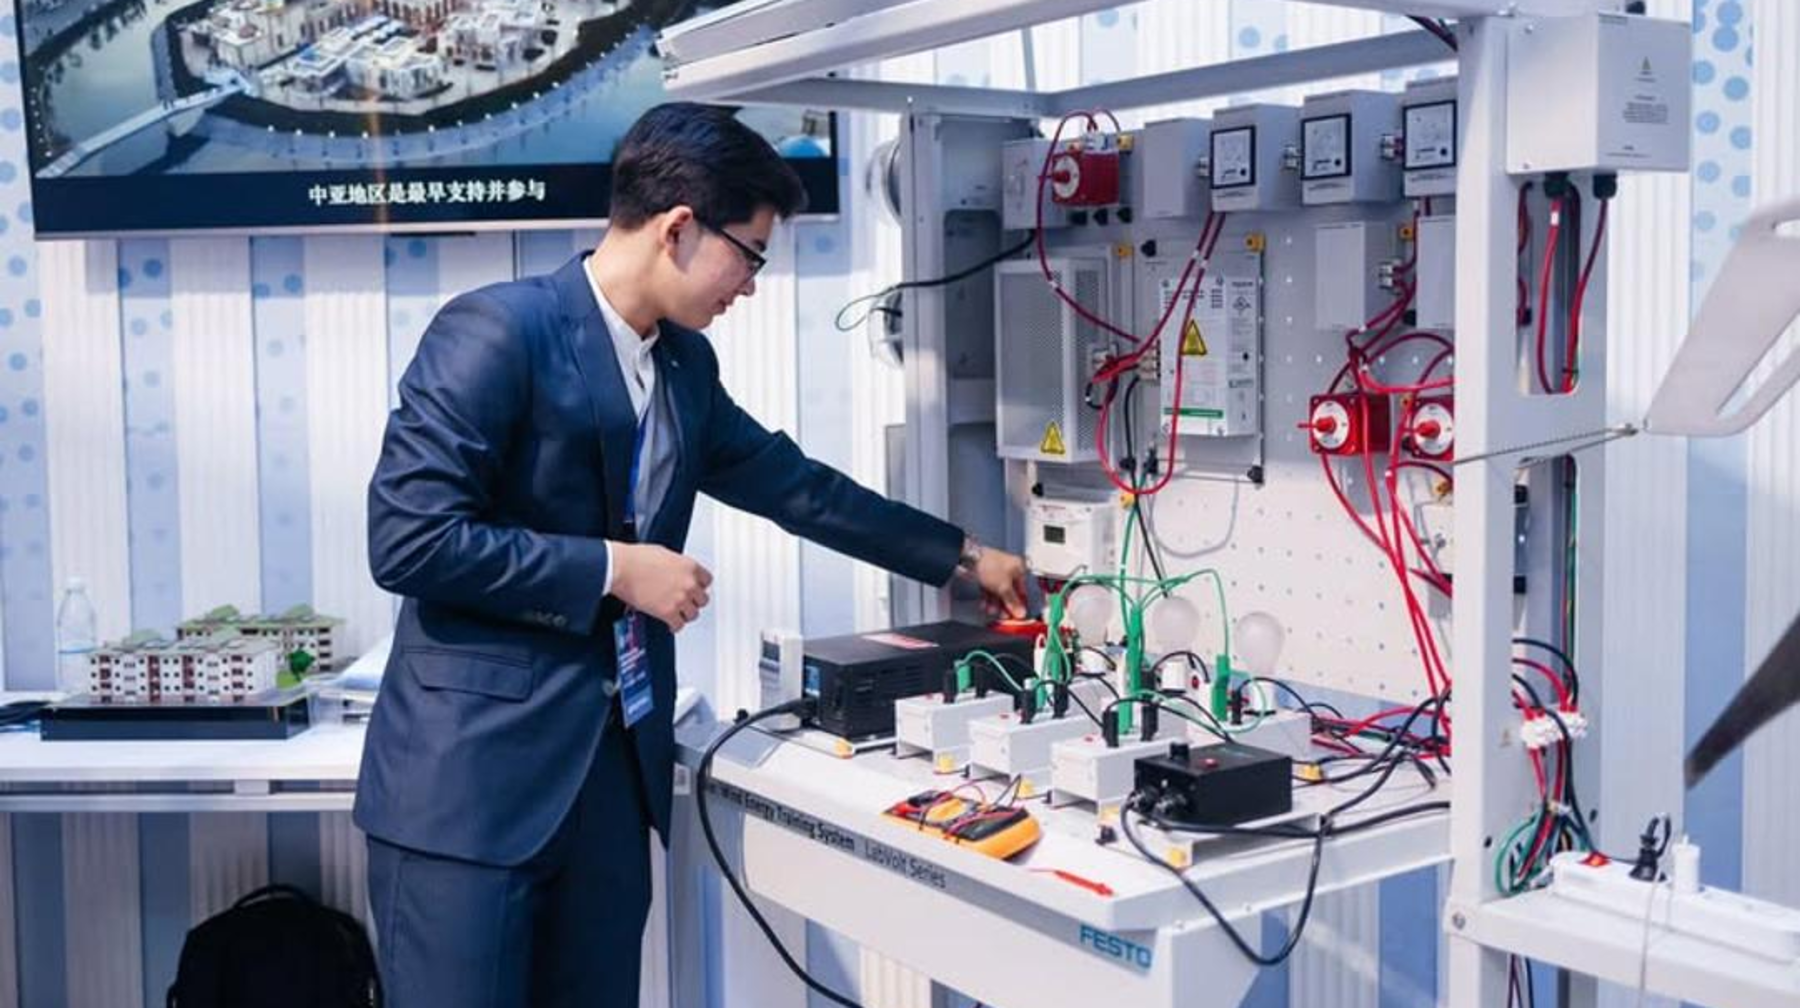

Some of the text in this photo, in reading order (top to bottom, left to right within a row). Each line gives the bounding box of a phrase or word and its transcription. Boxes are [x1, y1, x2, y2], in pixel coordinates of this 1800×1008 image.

[308, 179, 546, 206] 中亚地区是最早支持并参与
[745, 792, 775, 822] Energy
[777, 804, 816, 839] Training
[817, 821, 856, 852] System
[865, 839, 907, 875] LabVolt
[909, 857, 947, 889] Series
[1080, 923, 1153, 970] FESTO
